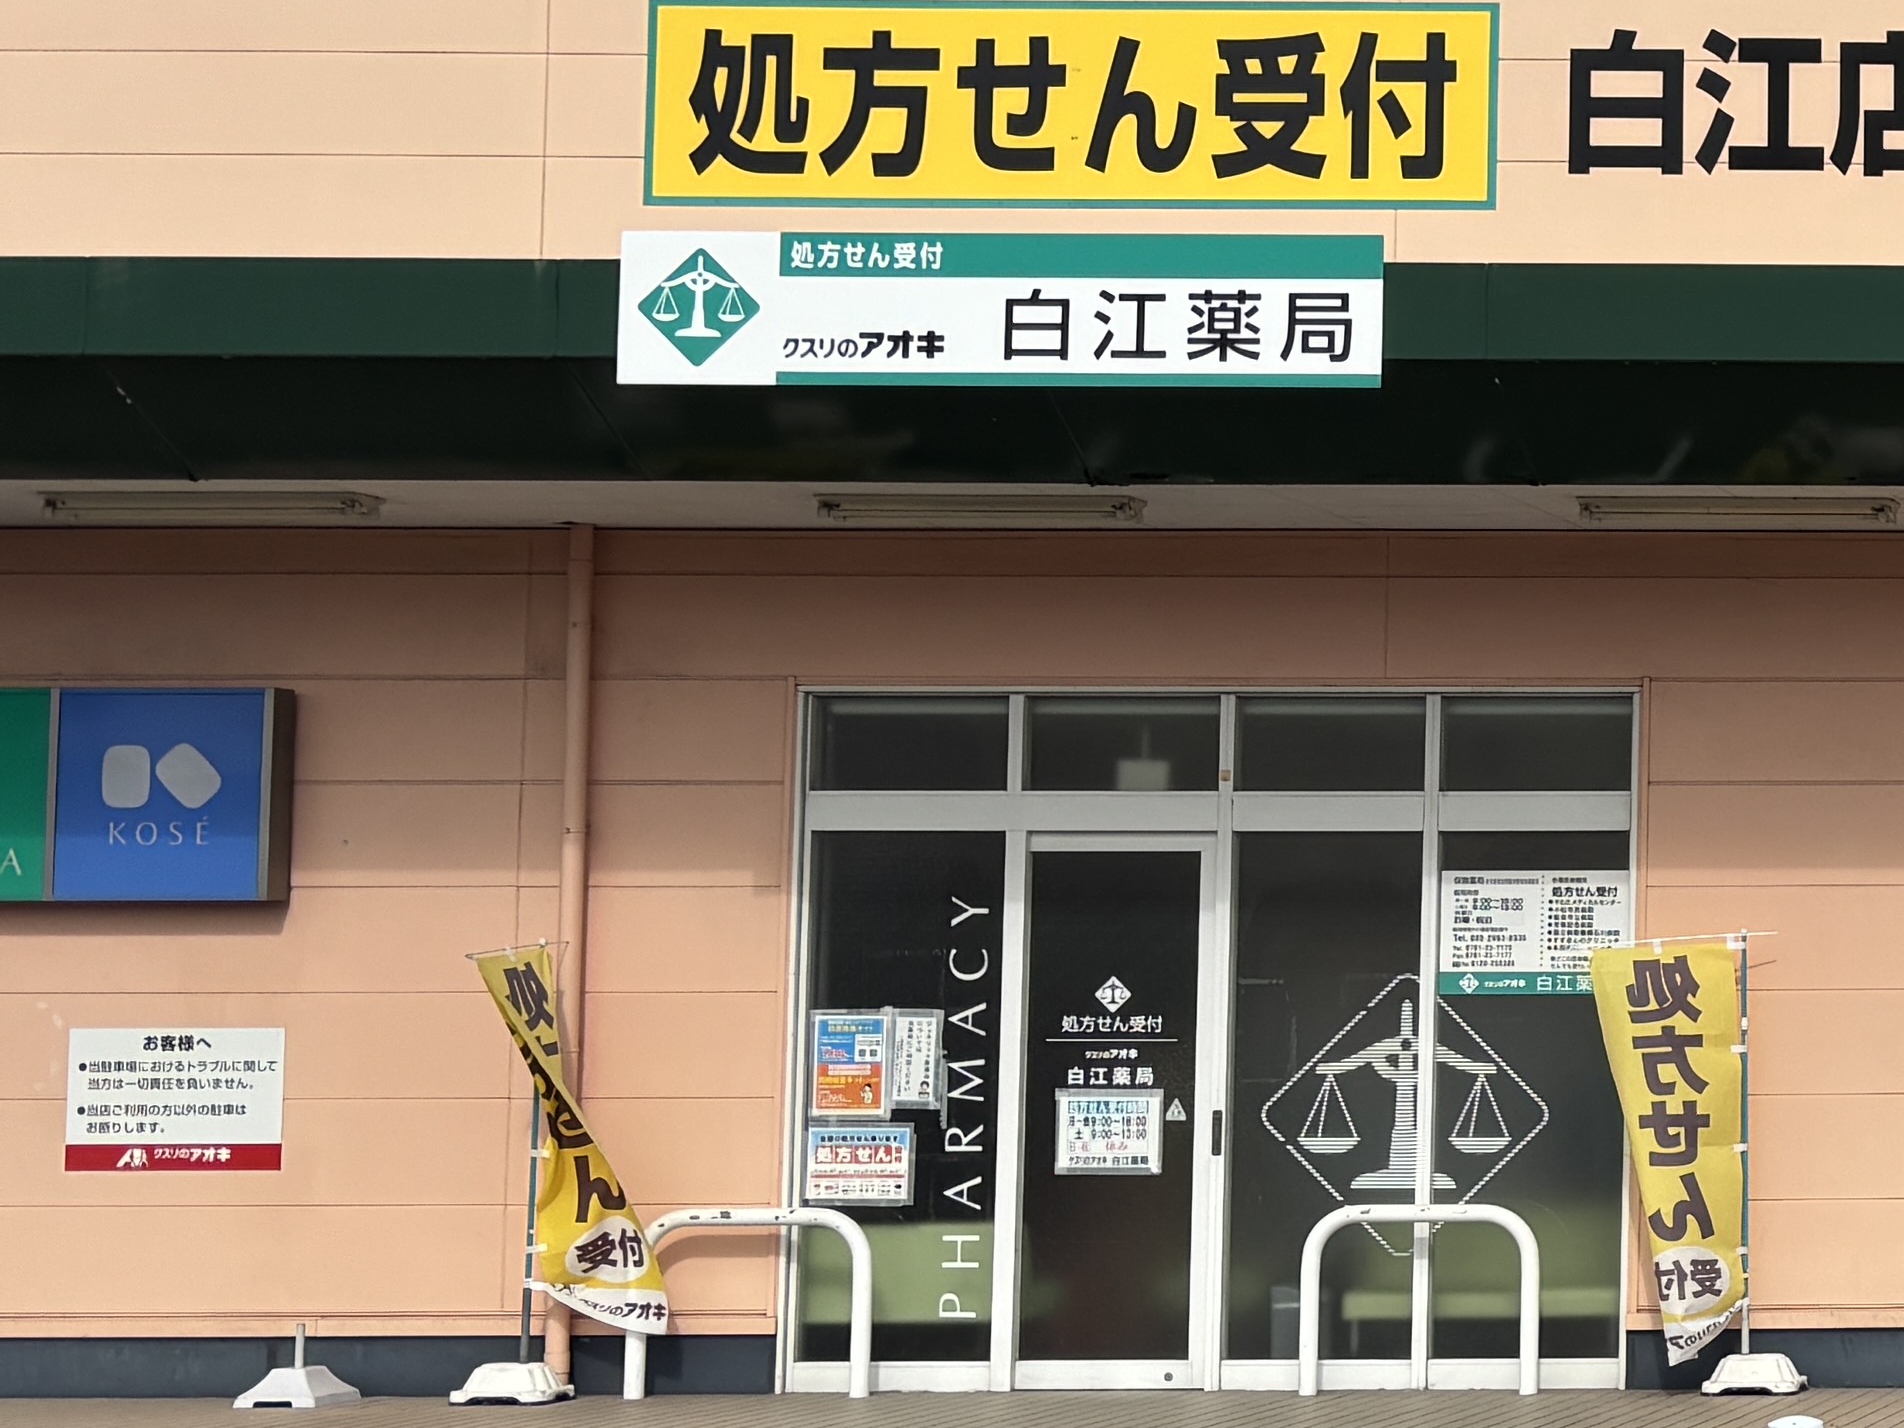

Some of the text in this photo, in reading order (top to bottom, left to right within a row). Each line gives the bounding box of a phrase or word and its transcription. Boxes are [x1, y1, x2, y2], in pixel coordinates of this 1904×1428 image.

[688, 27, 1458, 180] 処方せん受付
[790, 241, 944, 270] 処方せん受付
[782, 288, 1353, 364] クスリのアオキ 白江薬局
[109, 816, 209, 846] KOSÉ
[1552, 886, 1618, 897] 処方せん受付
[1537, 975, 1593, 992] 白江薬
[1061, 1015, 1162, 1032] 処方せん受付
[143, 1035, 212, 1052] お客様へ
[88, 1060, 278, 1073] 当駐車場におけるトラブルに関して
[1068, 1066, 1154, 1086] 白江薬局
[86, 1104, 247, 1117] 当店ご利用の方以外の駐車は
[939, 896, 990, 1319] PHARMACY
[154, 1147, 232, 1163] クスリのアオキ
[816, 1146, 891, 1163] 処方せん
[575, 1227, 645, 1274] 受付
